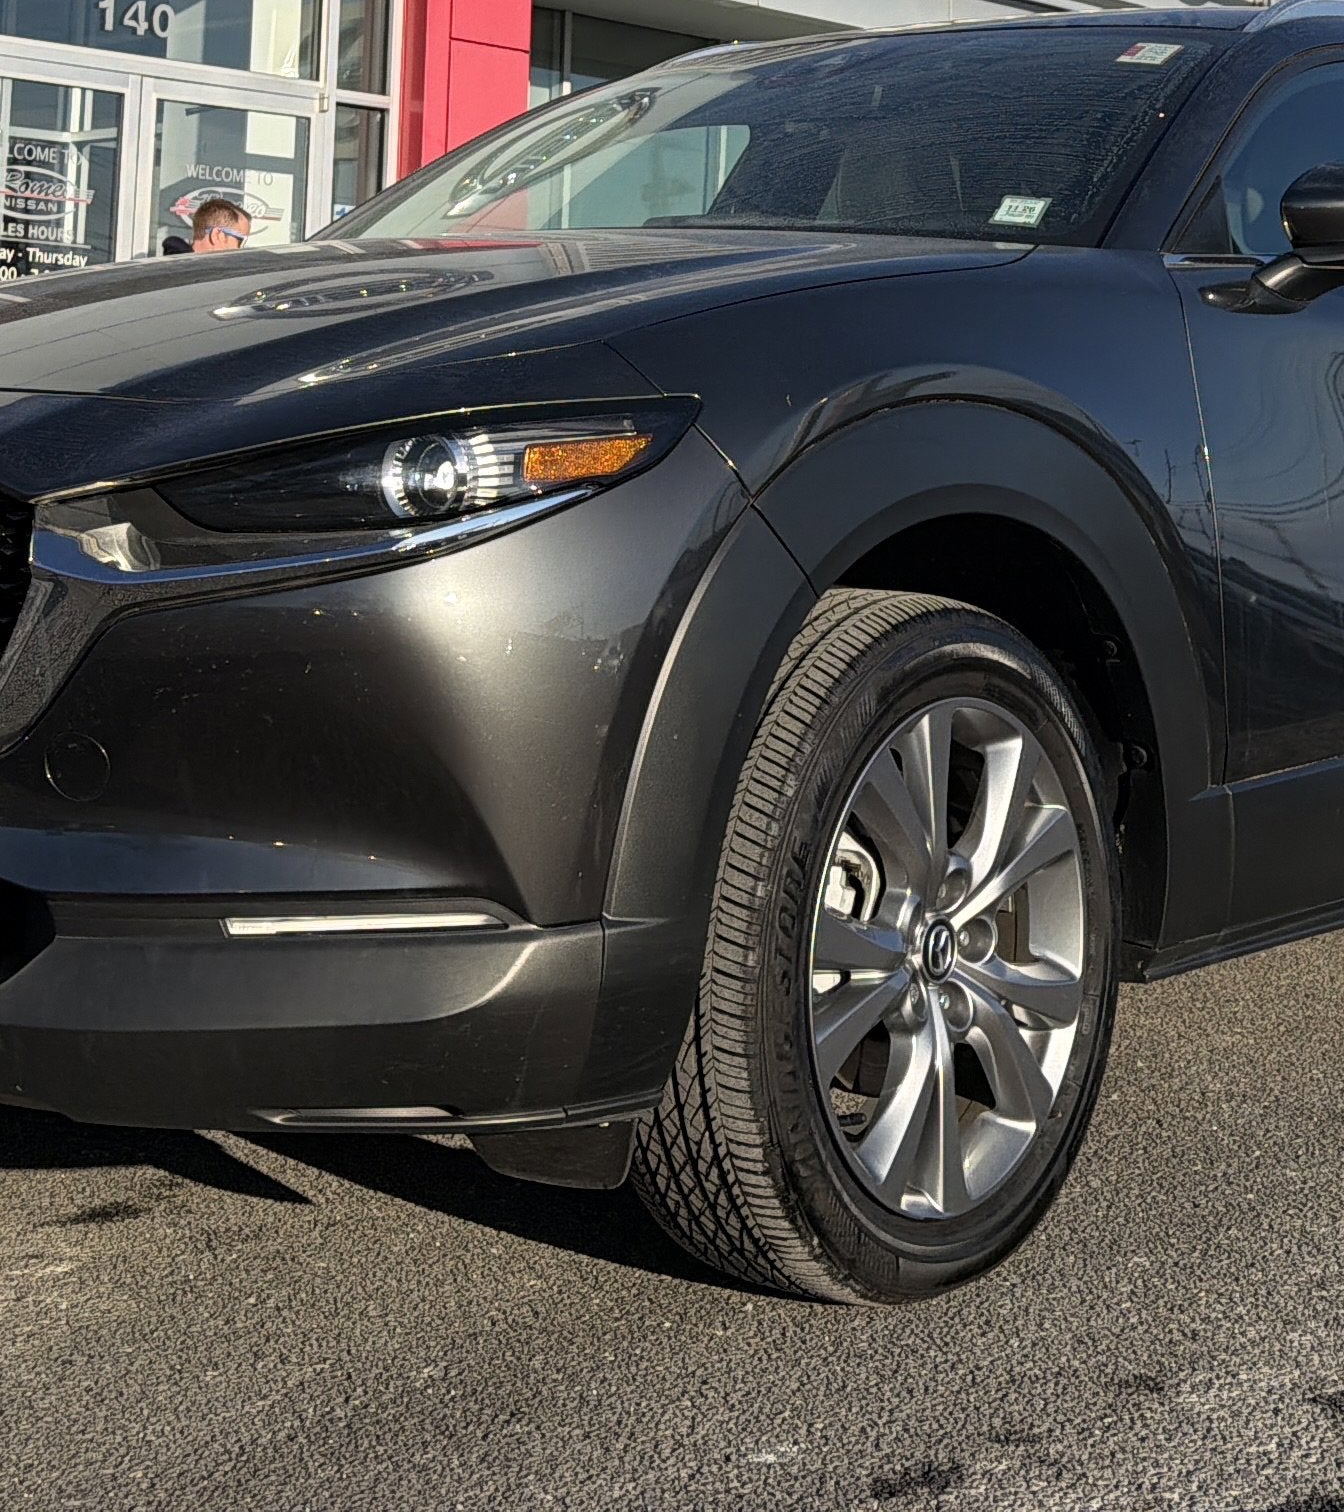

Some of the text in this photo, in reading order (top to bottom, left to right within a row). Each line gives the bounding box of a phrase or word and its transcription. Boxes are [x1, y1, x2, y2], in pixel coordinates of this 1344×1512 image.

[257, 171, 274, 187] TO
[2, 198, 58, 212] NISSAN
[26, 247, 88, 268] Thursday
